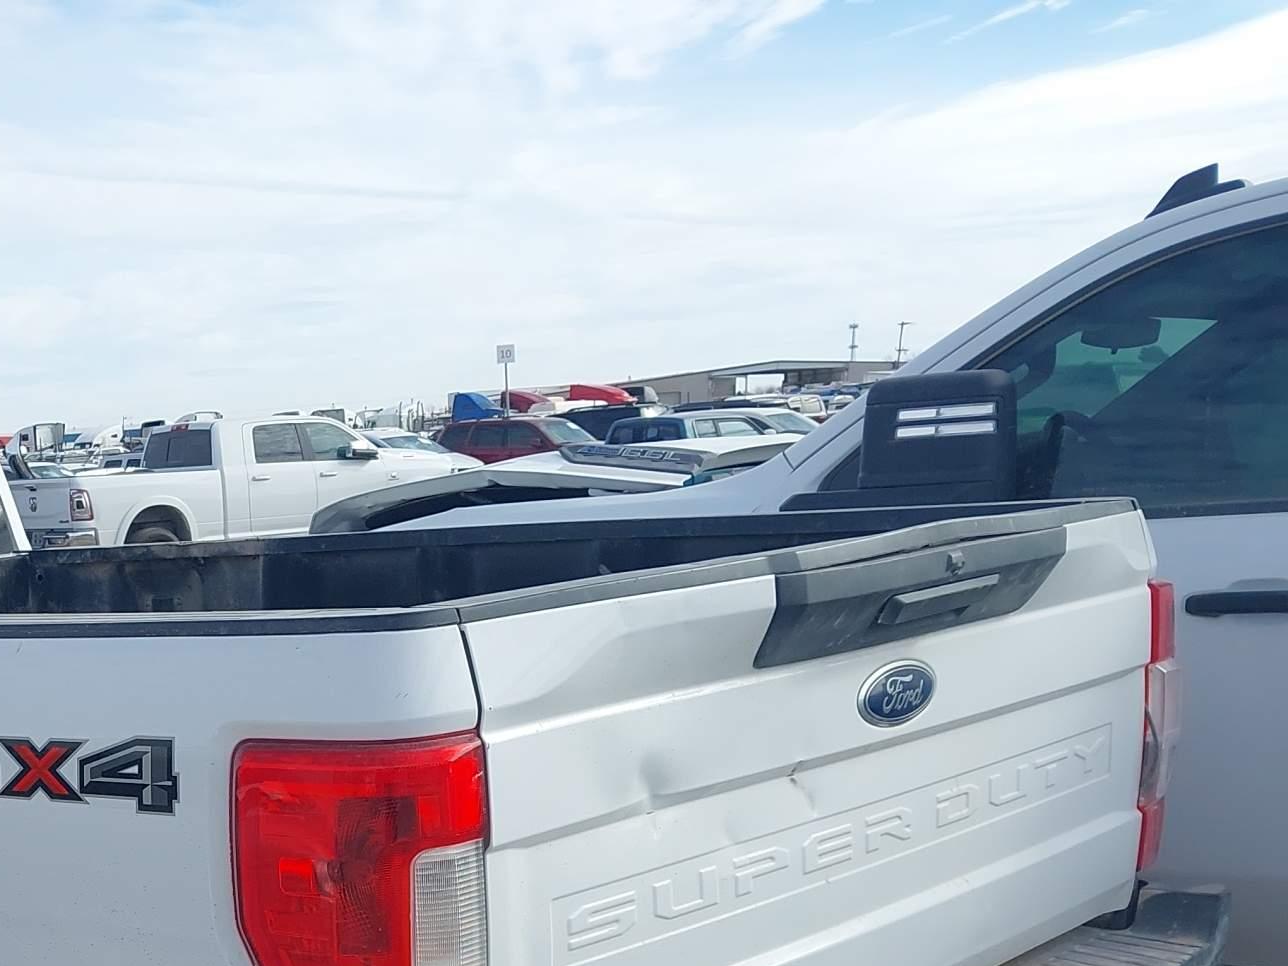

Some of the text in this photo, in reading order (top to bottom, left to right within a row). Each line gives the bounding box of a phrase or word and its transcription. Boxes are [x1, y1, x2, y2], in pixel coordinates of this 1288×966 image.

[500, 349, 512, 360] 10
[882, 674, 925, 714] Ford
[567, 737, 1107, 952] SUPER DUTY
